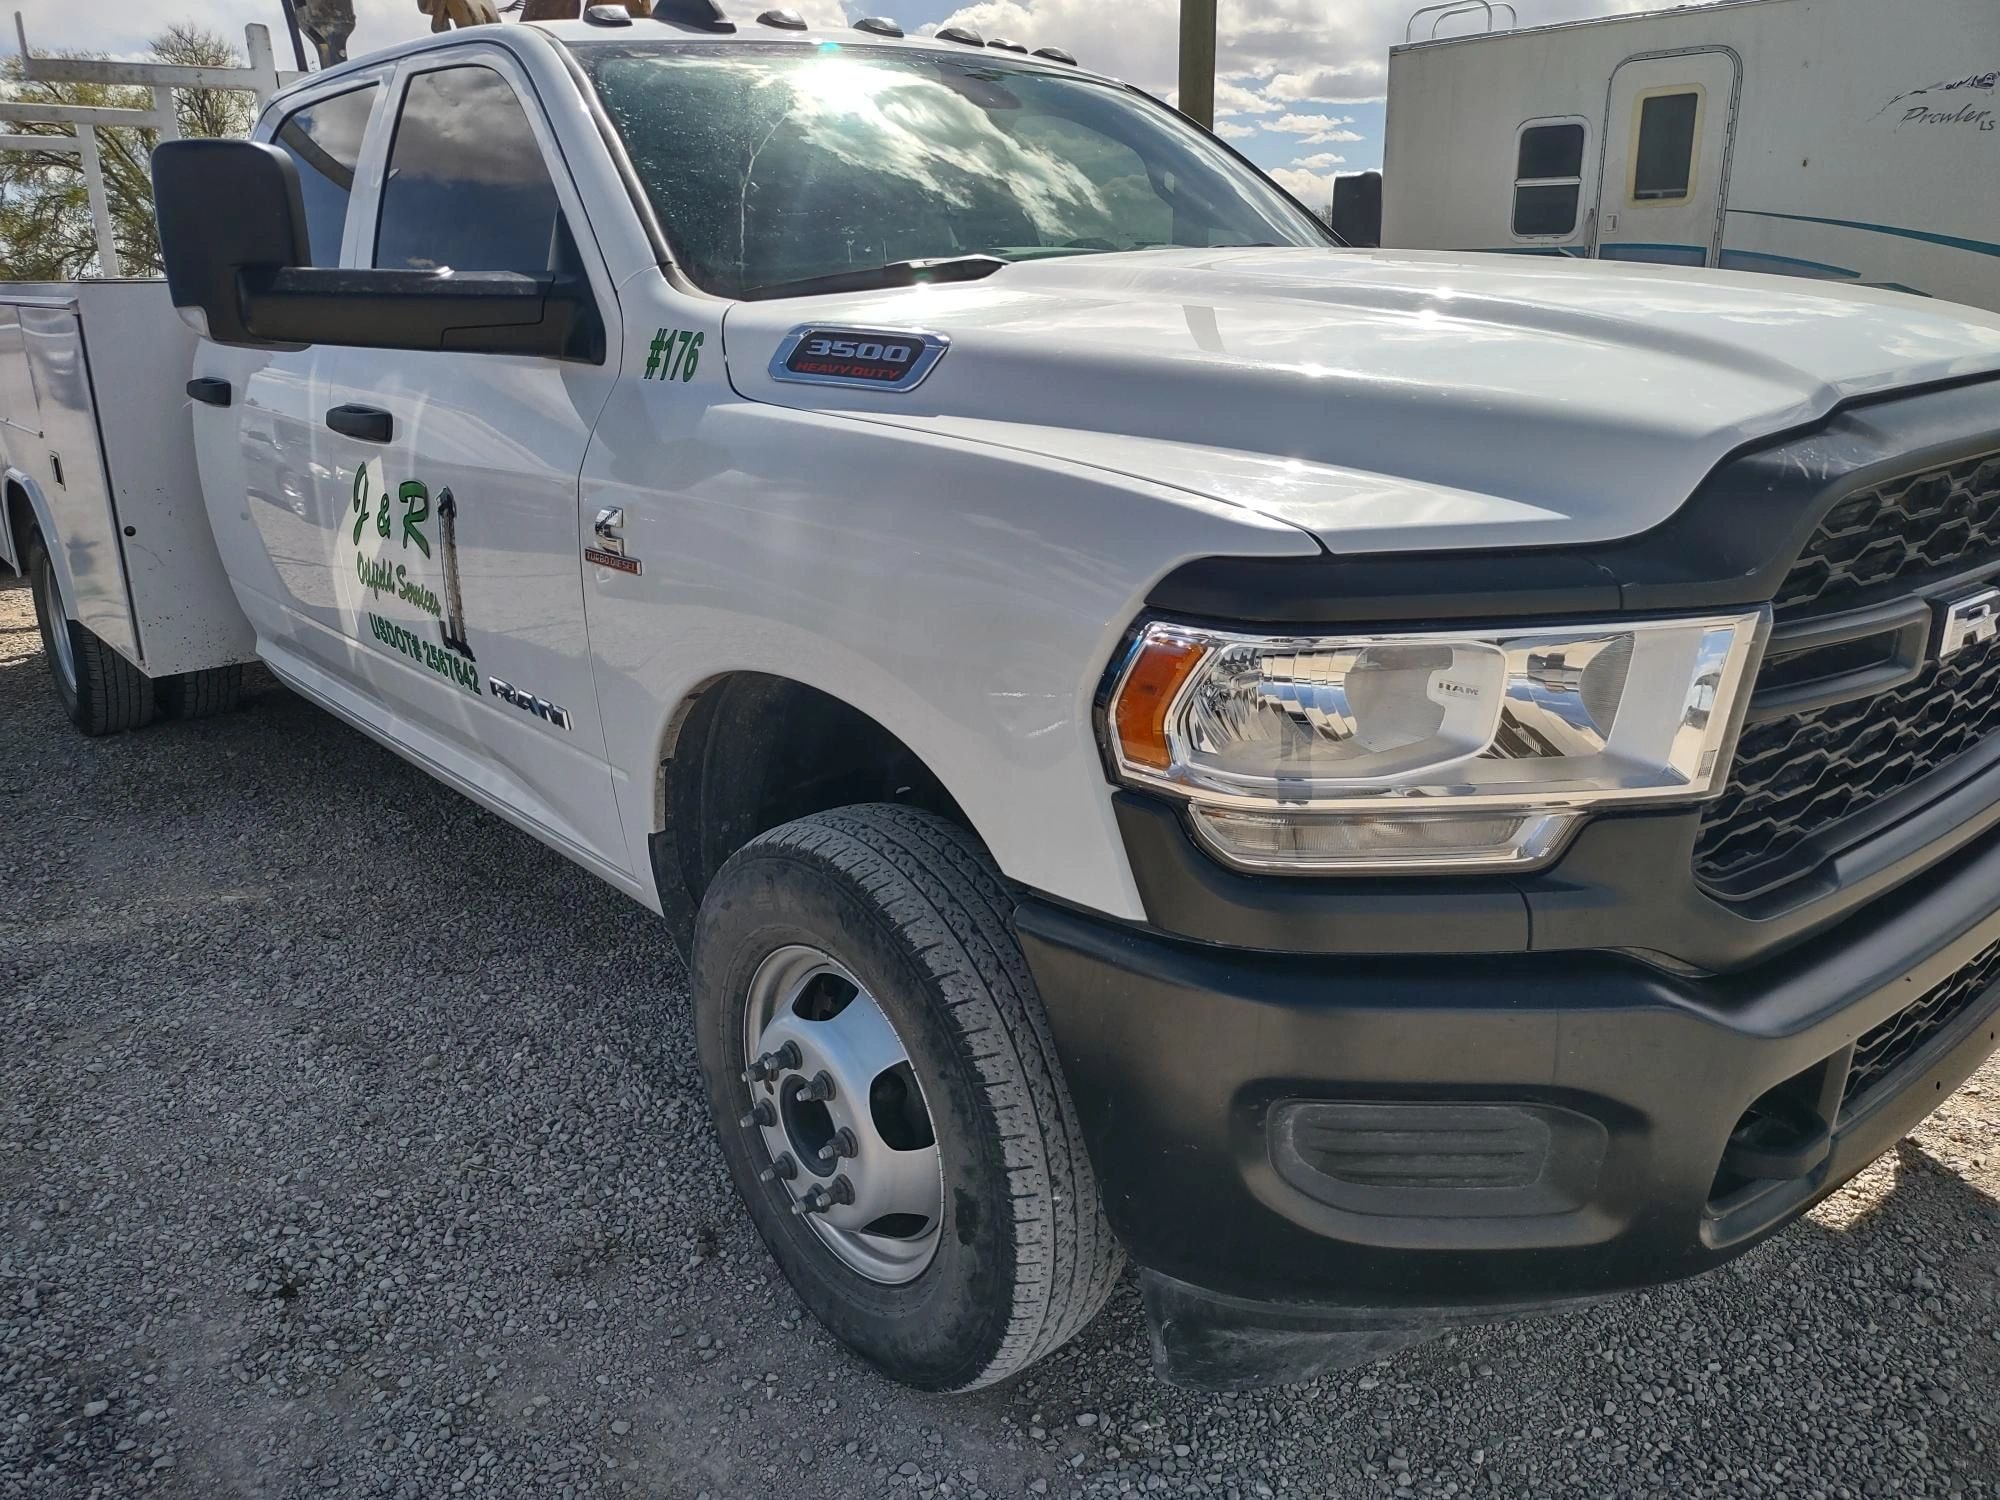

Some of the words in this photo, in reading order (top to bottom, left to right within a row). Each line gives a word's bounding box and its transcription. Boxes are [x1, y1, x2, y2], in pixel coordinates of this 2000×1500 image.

[1900, 103, 1991, 124] Prowler
[1979, 120, 1995, 131] LS
[643, 328, 705, 383] #176
[794, 362, 850, 374] HEAVY
[850, 366, 900, 380] DUTY
[806, 339, 912, 363] 3500
[353, 461, 370, 546] J
[377, 493, 391, 539] &
[399, 481, 430, 560] R
[586, 551, 609, 564] TURBO
[610, 557, 637, 571] DIESEL
[357, 551, 395, 600] Oilfield
[396, 565, 441, 618] Services
[368, 611, 422, 663] USDOT#
